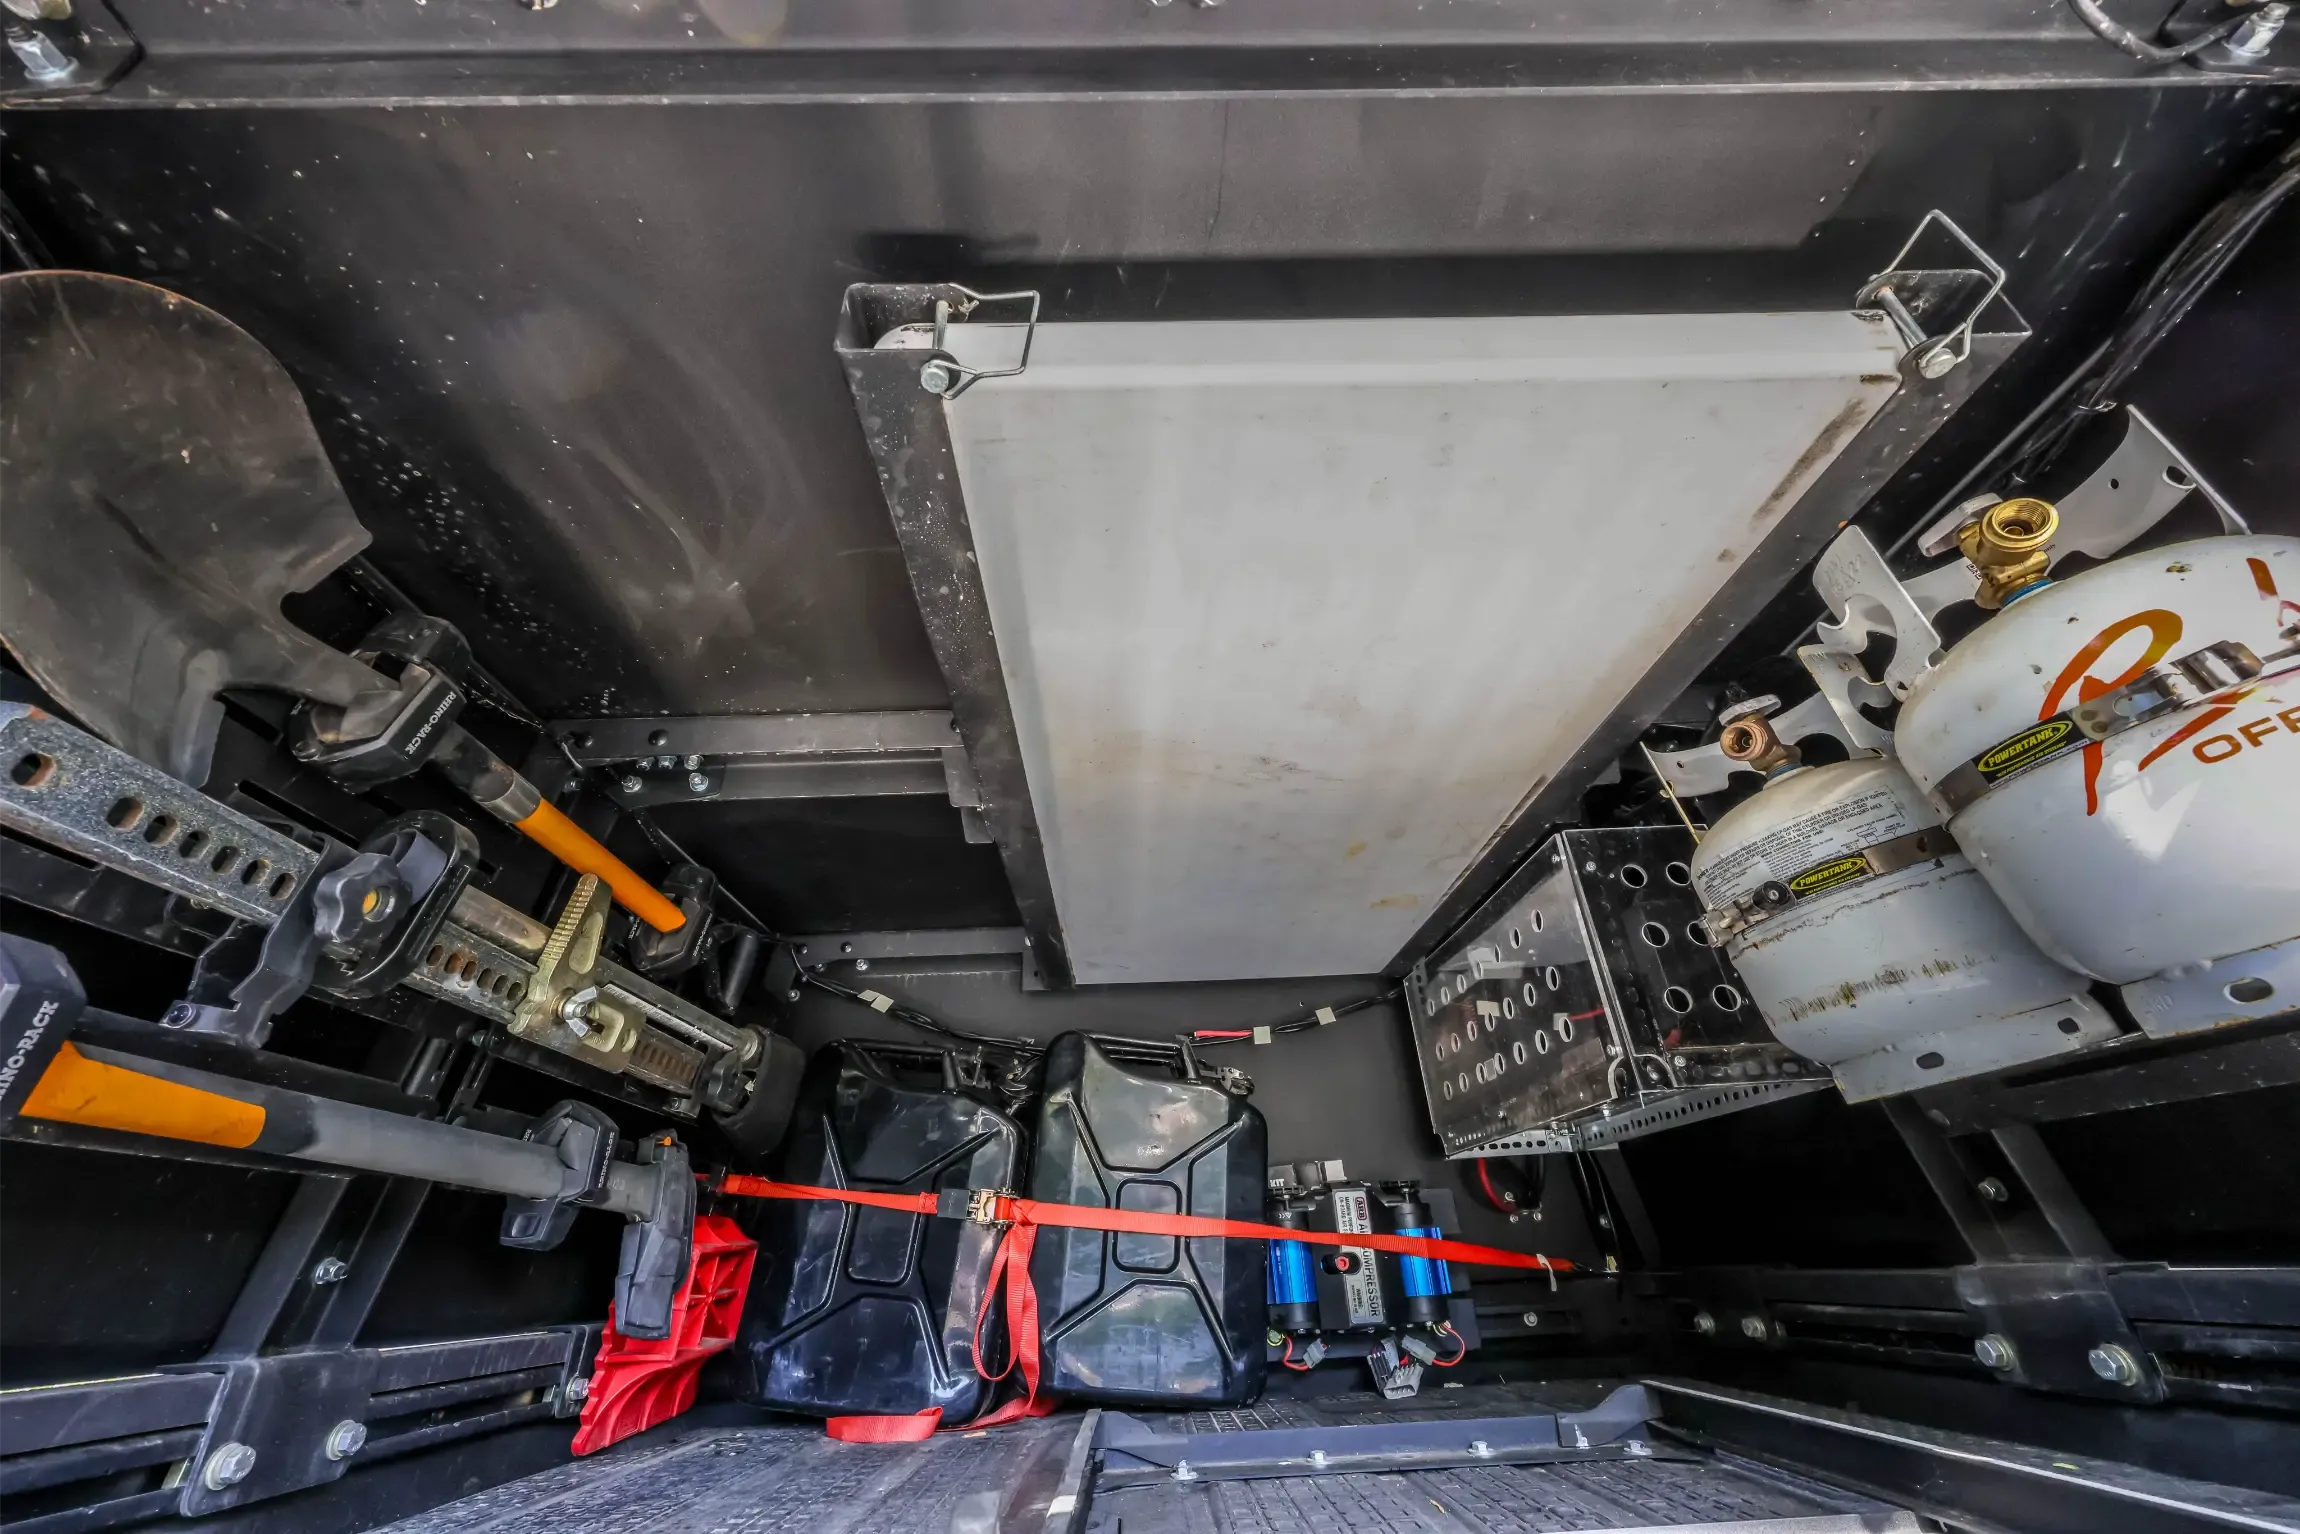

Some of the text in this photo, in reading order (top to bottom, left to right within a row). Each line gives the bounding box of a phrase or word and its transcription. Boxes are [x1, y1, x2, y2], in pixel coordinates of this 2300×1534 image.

[405, 691, 457, 755] RHINO-RACK
[1988, 727, 2054, 767] POWERTANK
[1798, 861, 1853, 886] POWERTANK
[1356, 1199, 1365, 1218] ARB
[1361, 1247, 1380, 1317] OMPRESSOR
